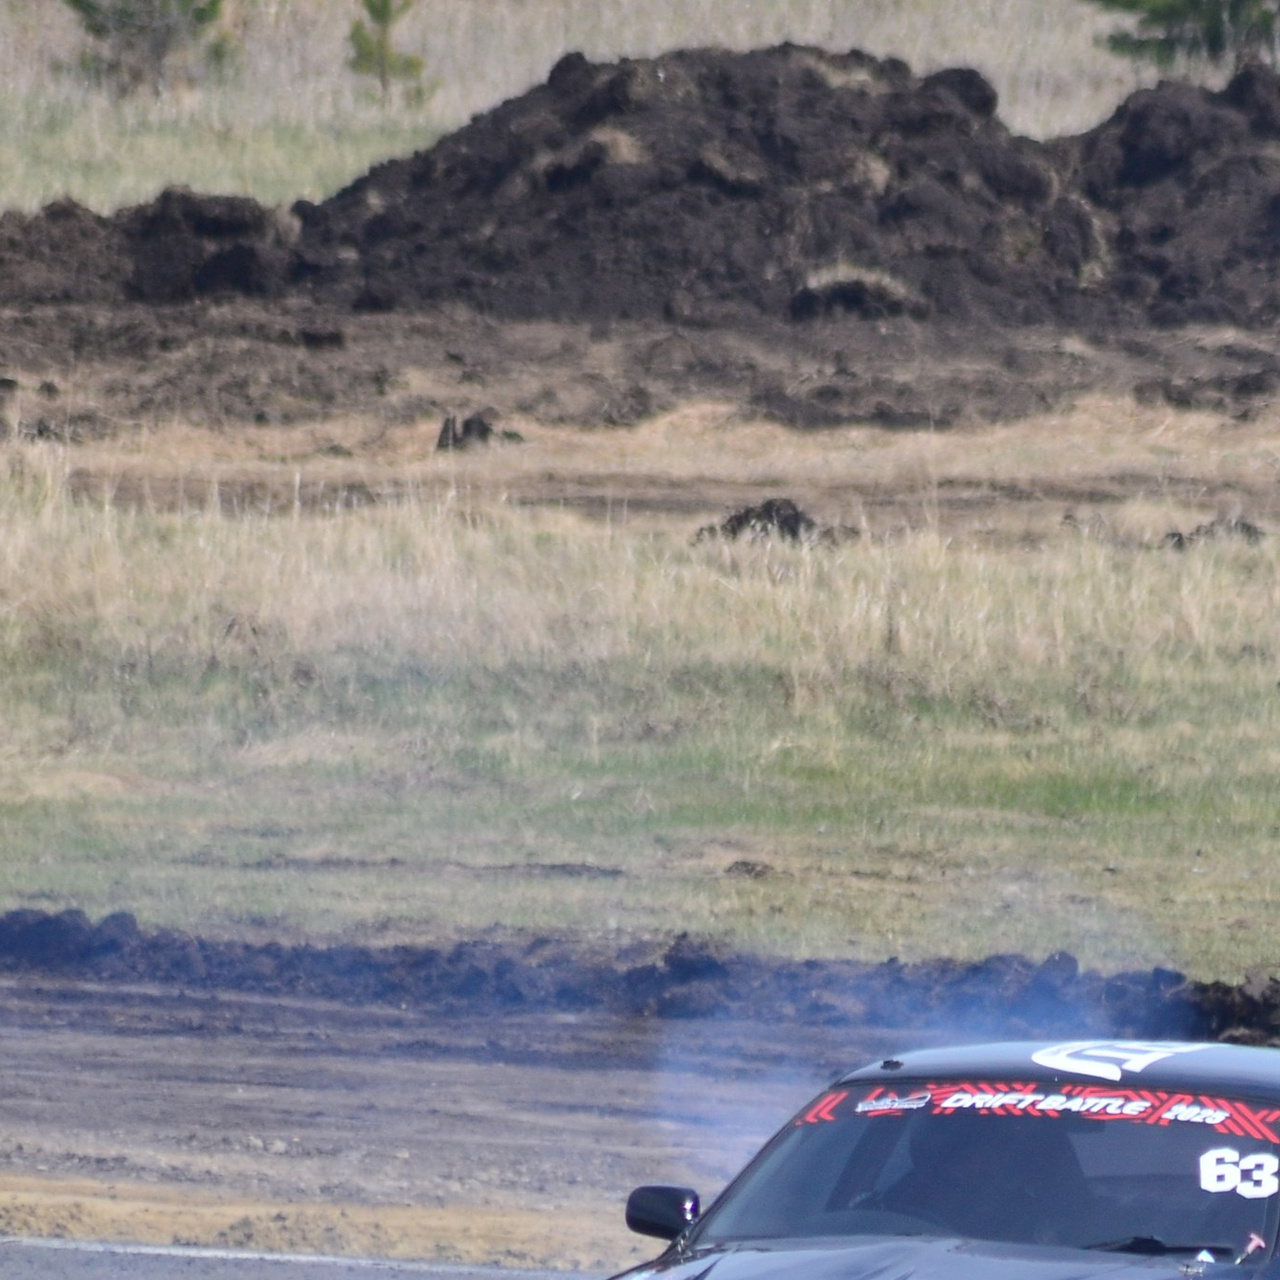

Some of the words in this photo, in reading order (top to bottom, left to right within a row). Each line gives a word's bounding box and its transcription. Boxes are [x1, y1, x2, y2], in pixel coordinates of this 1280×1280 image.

[941, 1092, 1044, 1110] DRIFT
[1036, 1094, 1152, 1116] BATTLE
[1161, 1103, 1231, 1125] 2025
[1199, 1147, 1280, 1200] 63
